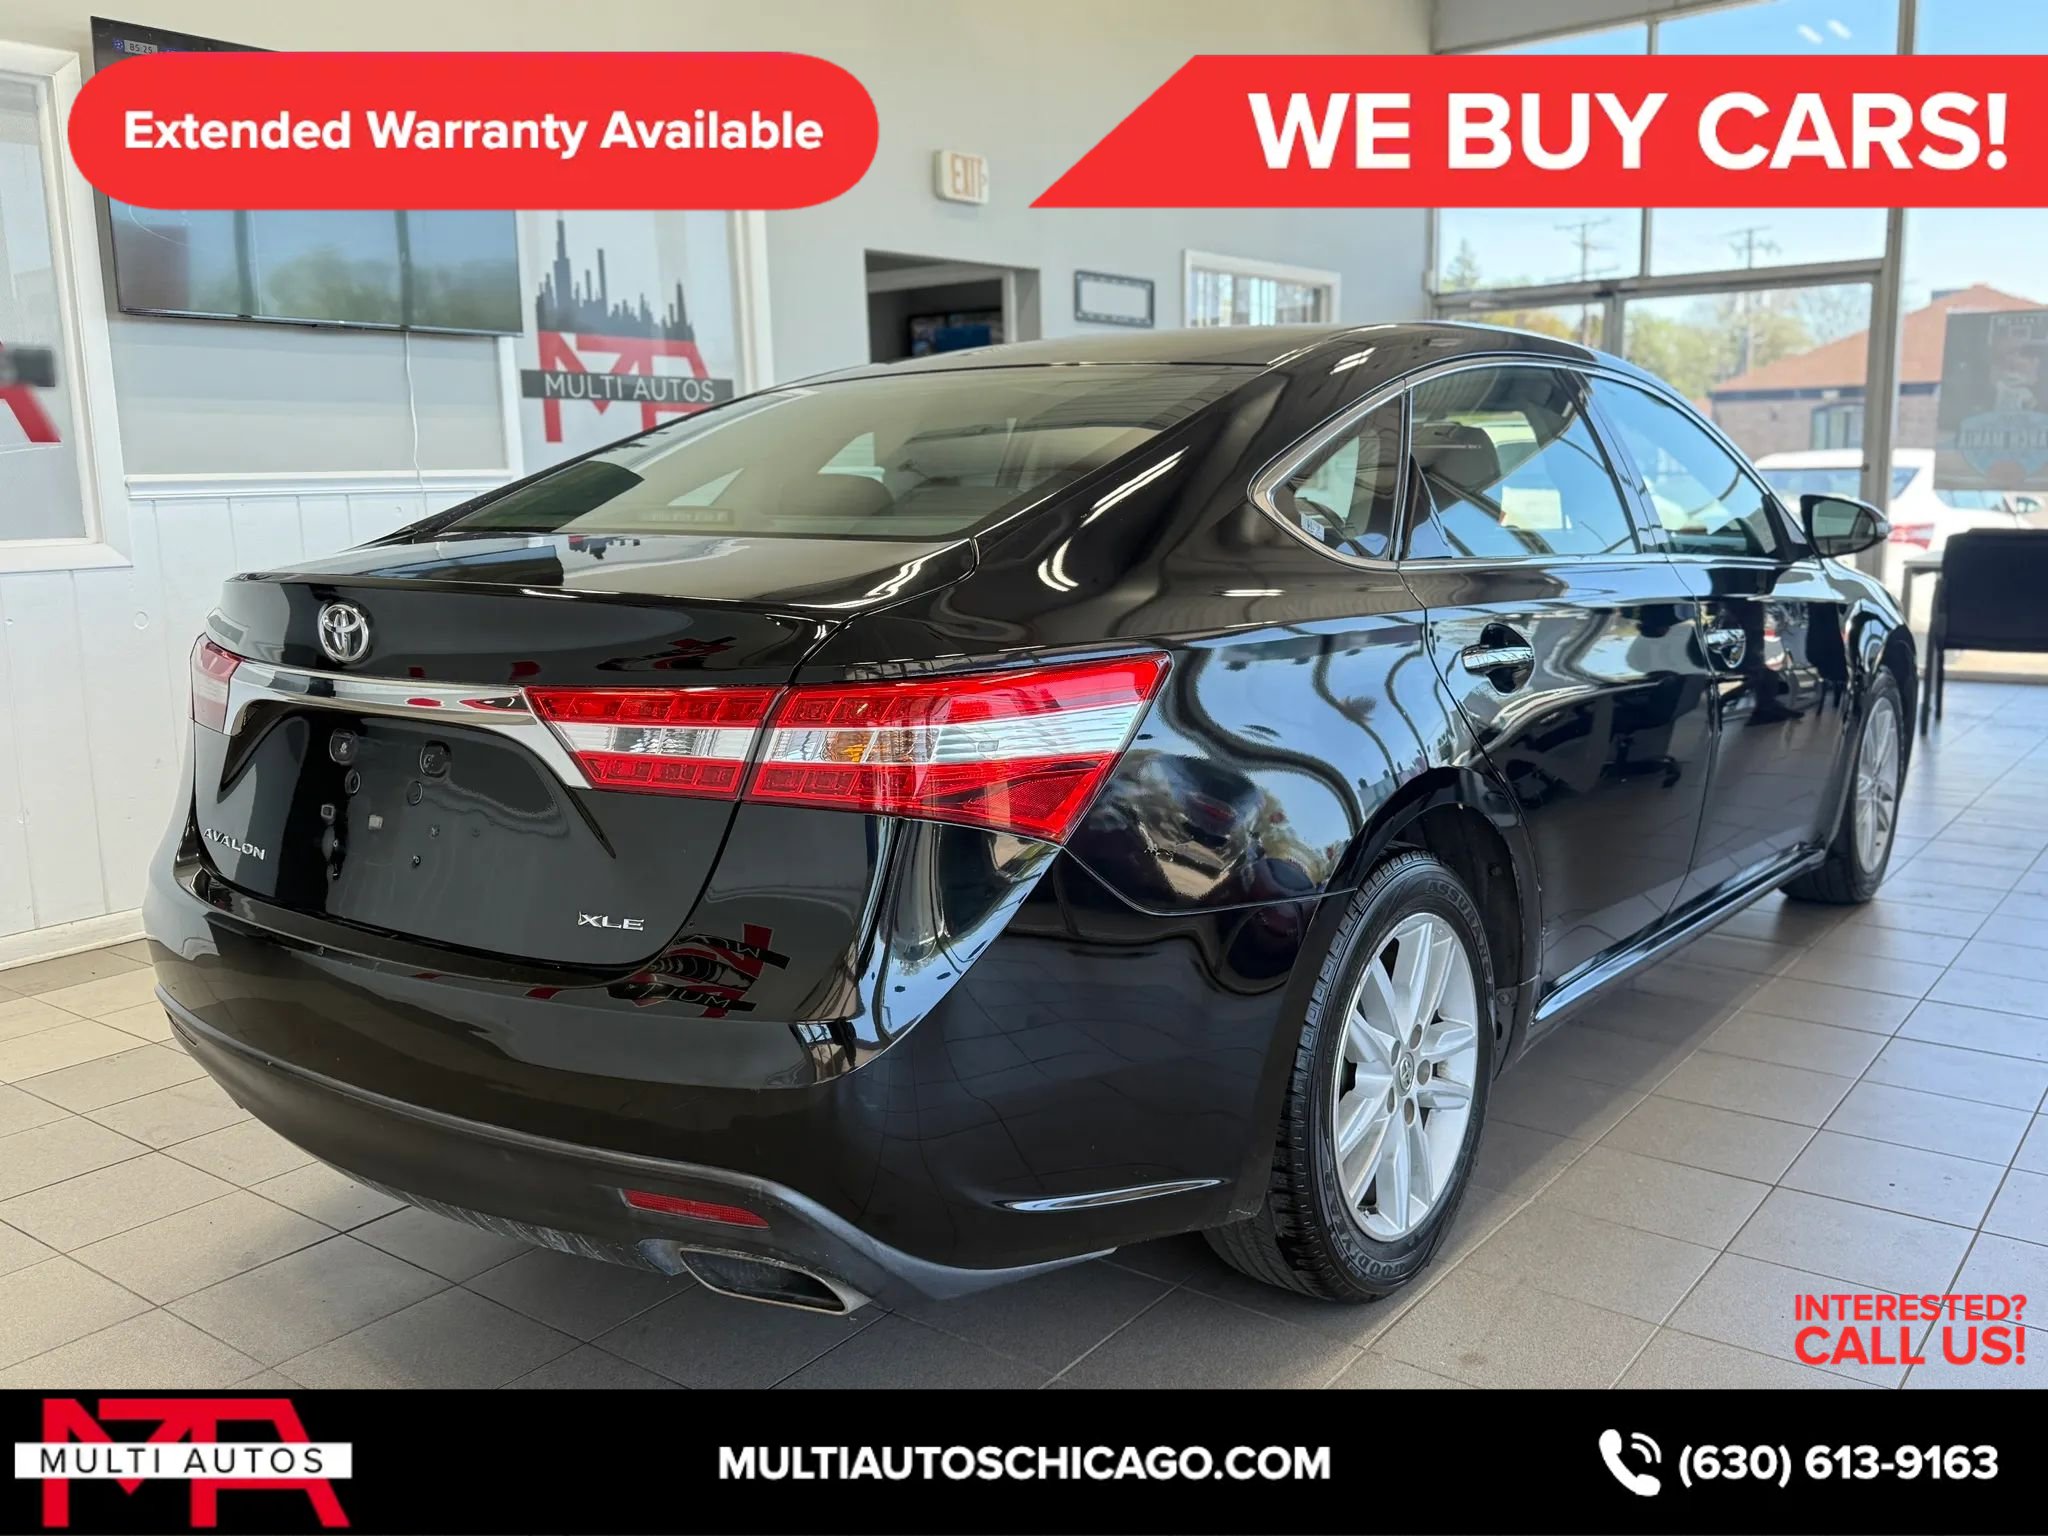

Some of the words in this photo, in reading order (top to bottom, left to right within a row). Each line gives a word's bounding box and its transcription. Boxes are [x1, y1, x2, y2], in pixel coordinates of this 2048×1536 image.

[950, 154, 983, 199] EXIT
[544, 373, 624, 399] MULTI
[632, 375, 716, 403] AUTOS
[203, 828, 266, 861] AVALON
[577, 911, 645, 931] XLE
